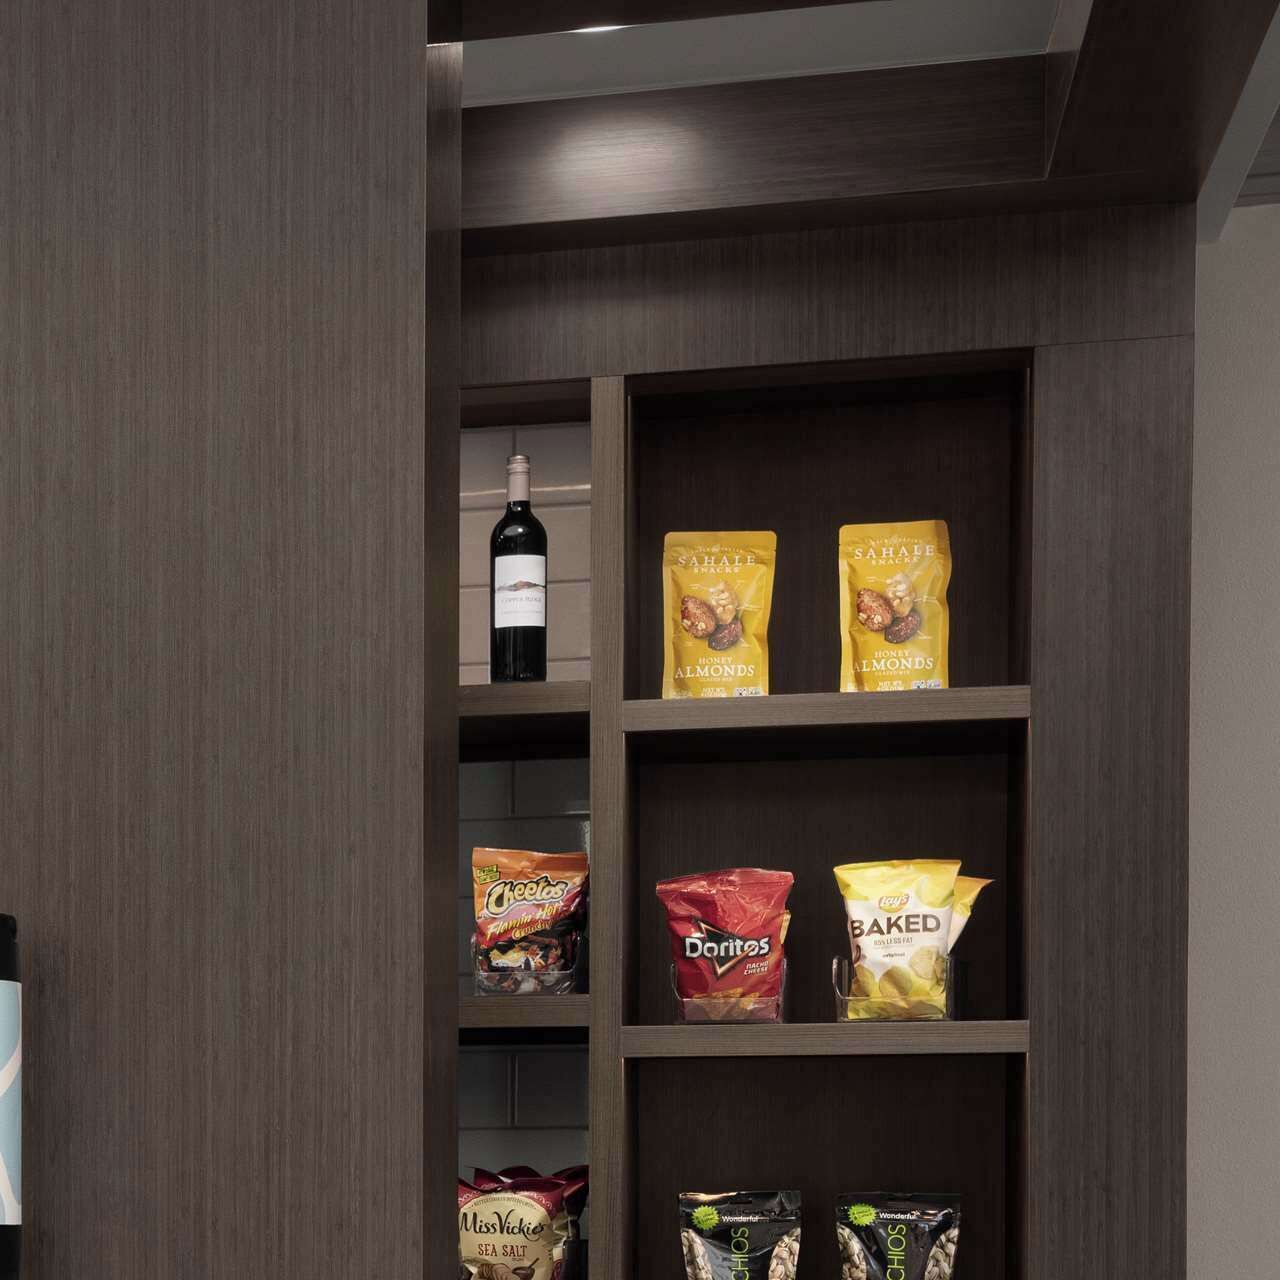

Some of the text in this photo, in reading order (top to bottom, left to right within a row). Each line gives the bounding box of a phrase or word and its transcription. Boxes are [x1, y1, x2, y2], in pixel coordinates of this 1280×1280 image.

[854, 545, 935, 559] SAHALE
[677, 555, 756, 567] SAHALE
[698, 656, 732, 664] HONEY
[874, 650, 911, 658] HONEY
[675, 665, 755, 679] ALMONDS
[853, 657, 934, 673] ALMONDS
[486, 875, 568, 916] Cheetos
[851, 914, 940, 939] BAKED
[685, 936, 770, 959] Doritos
[744, 967, 769, 976] CHEESE
[746, 961, 769, 969] NACHO
[721, 1215, 759, 1223] Wonderful
[879, 1211, 917, 1220] Wonderful
[460, 1211, 496, 1235] Miss
[478, 1243, 528, 1257] SEA SALT
